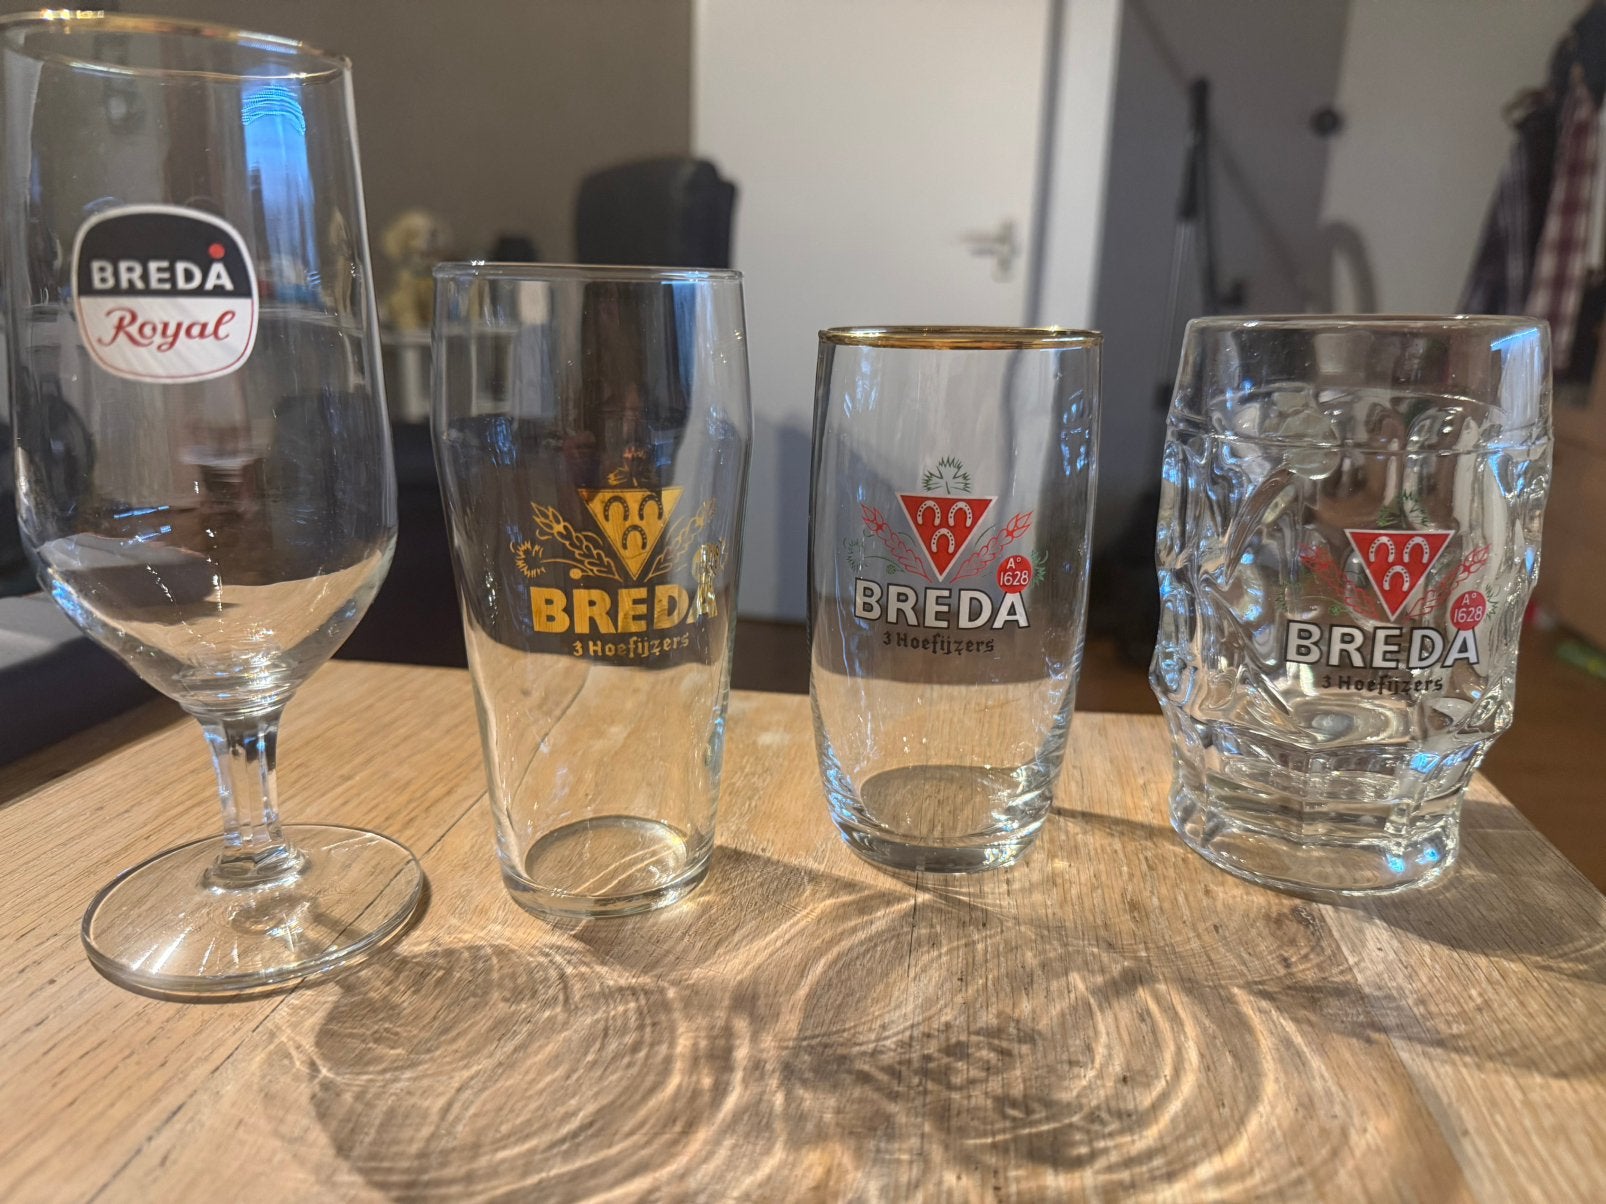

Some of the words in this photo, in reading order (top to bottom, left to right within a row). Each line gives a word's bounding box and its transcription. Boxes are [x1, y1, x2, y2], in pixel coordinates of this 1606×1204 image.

[90, 260, 234, 290] BREDA
[97, 307, 236, 352] Royal
[1000, 571, 1029, 586] 1628
[530, 584, 718, 634] BREDA
[854, 577, 1030, 630] BREDA
[1453, 606, 1484, 624] 1628
[573, 641, 583, 656] 3
[588, 632, 689, 658] Hoefijzers
[883, 632, 891, 645] 3
[897, 633, 995, 655] Hoefijzers
[1285, 620, 1480, 669] BREDA
[1321, 675, 1332, 690] 3
